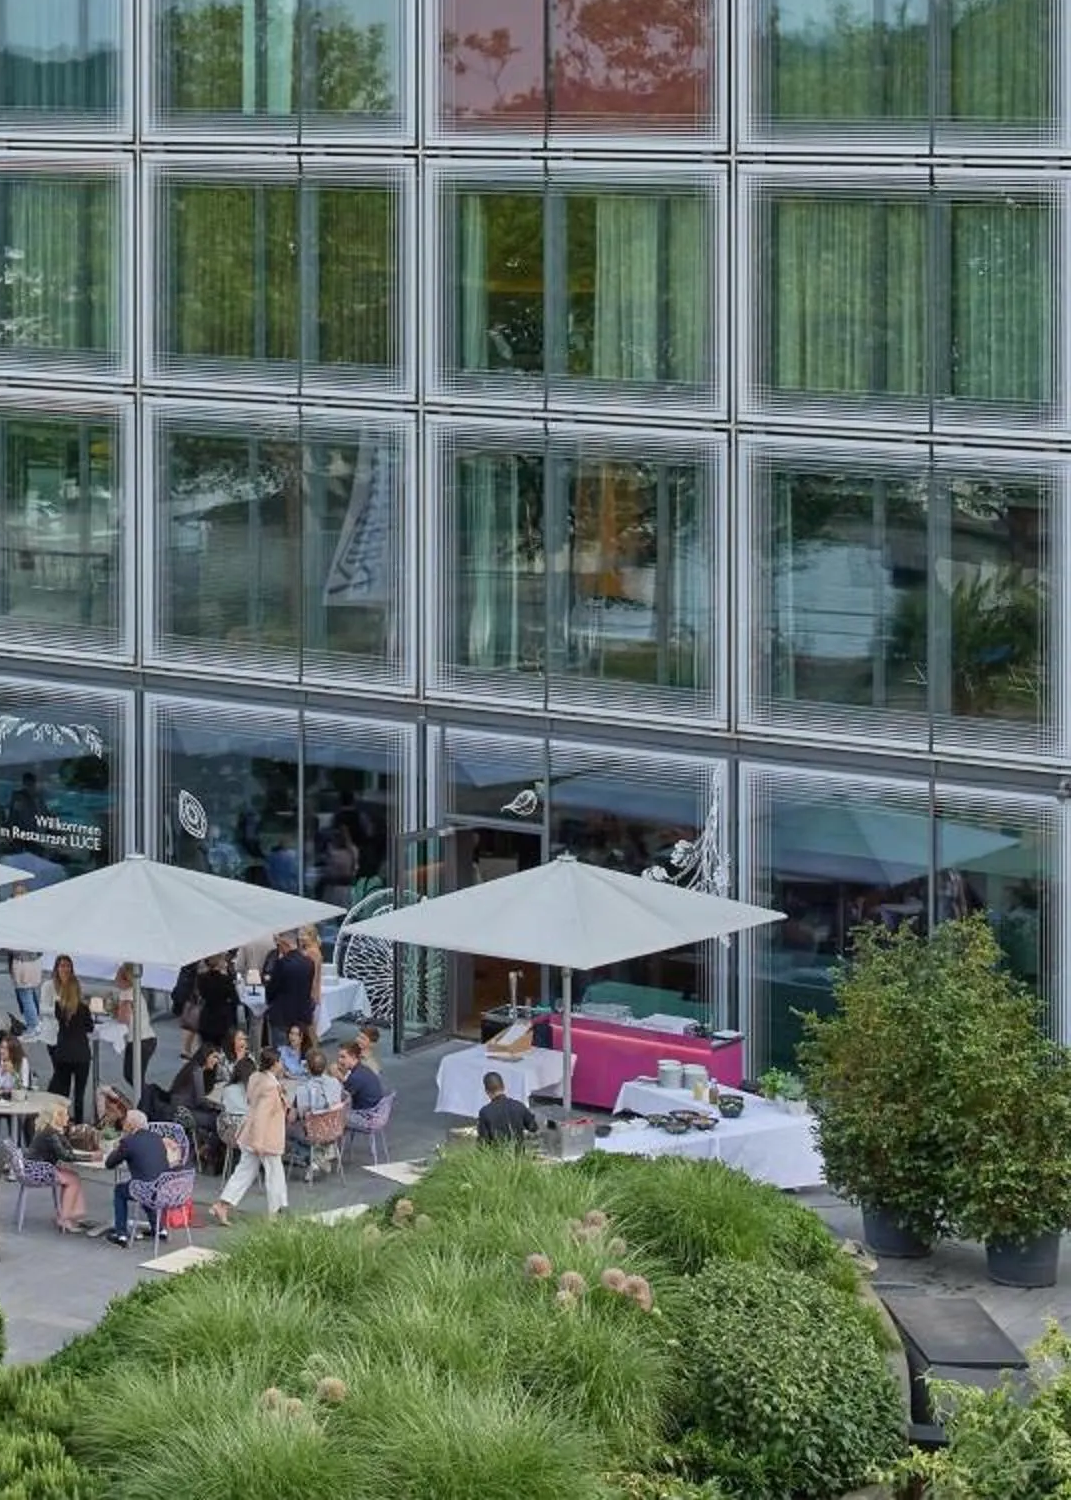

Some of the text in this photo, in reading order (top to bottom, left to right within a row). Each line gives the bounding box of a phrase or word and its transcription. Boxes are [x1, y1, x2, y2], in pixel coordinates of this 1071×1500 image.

[34, 814, 102, 837] Willkommen
[12, 825, 67, 846] Restaurant
[70, 834, 102, 851] LUCE
